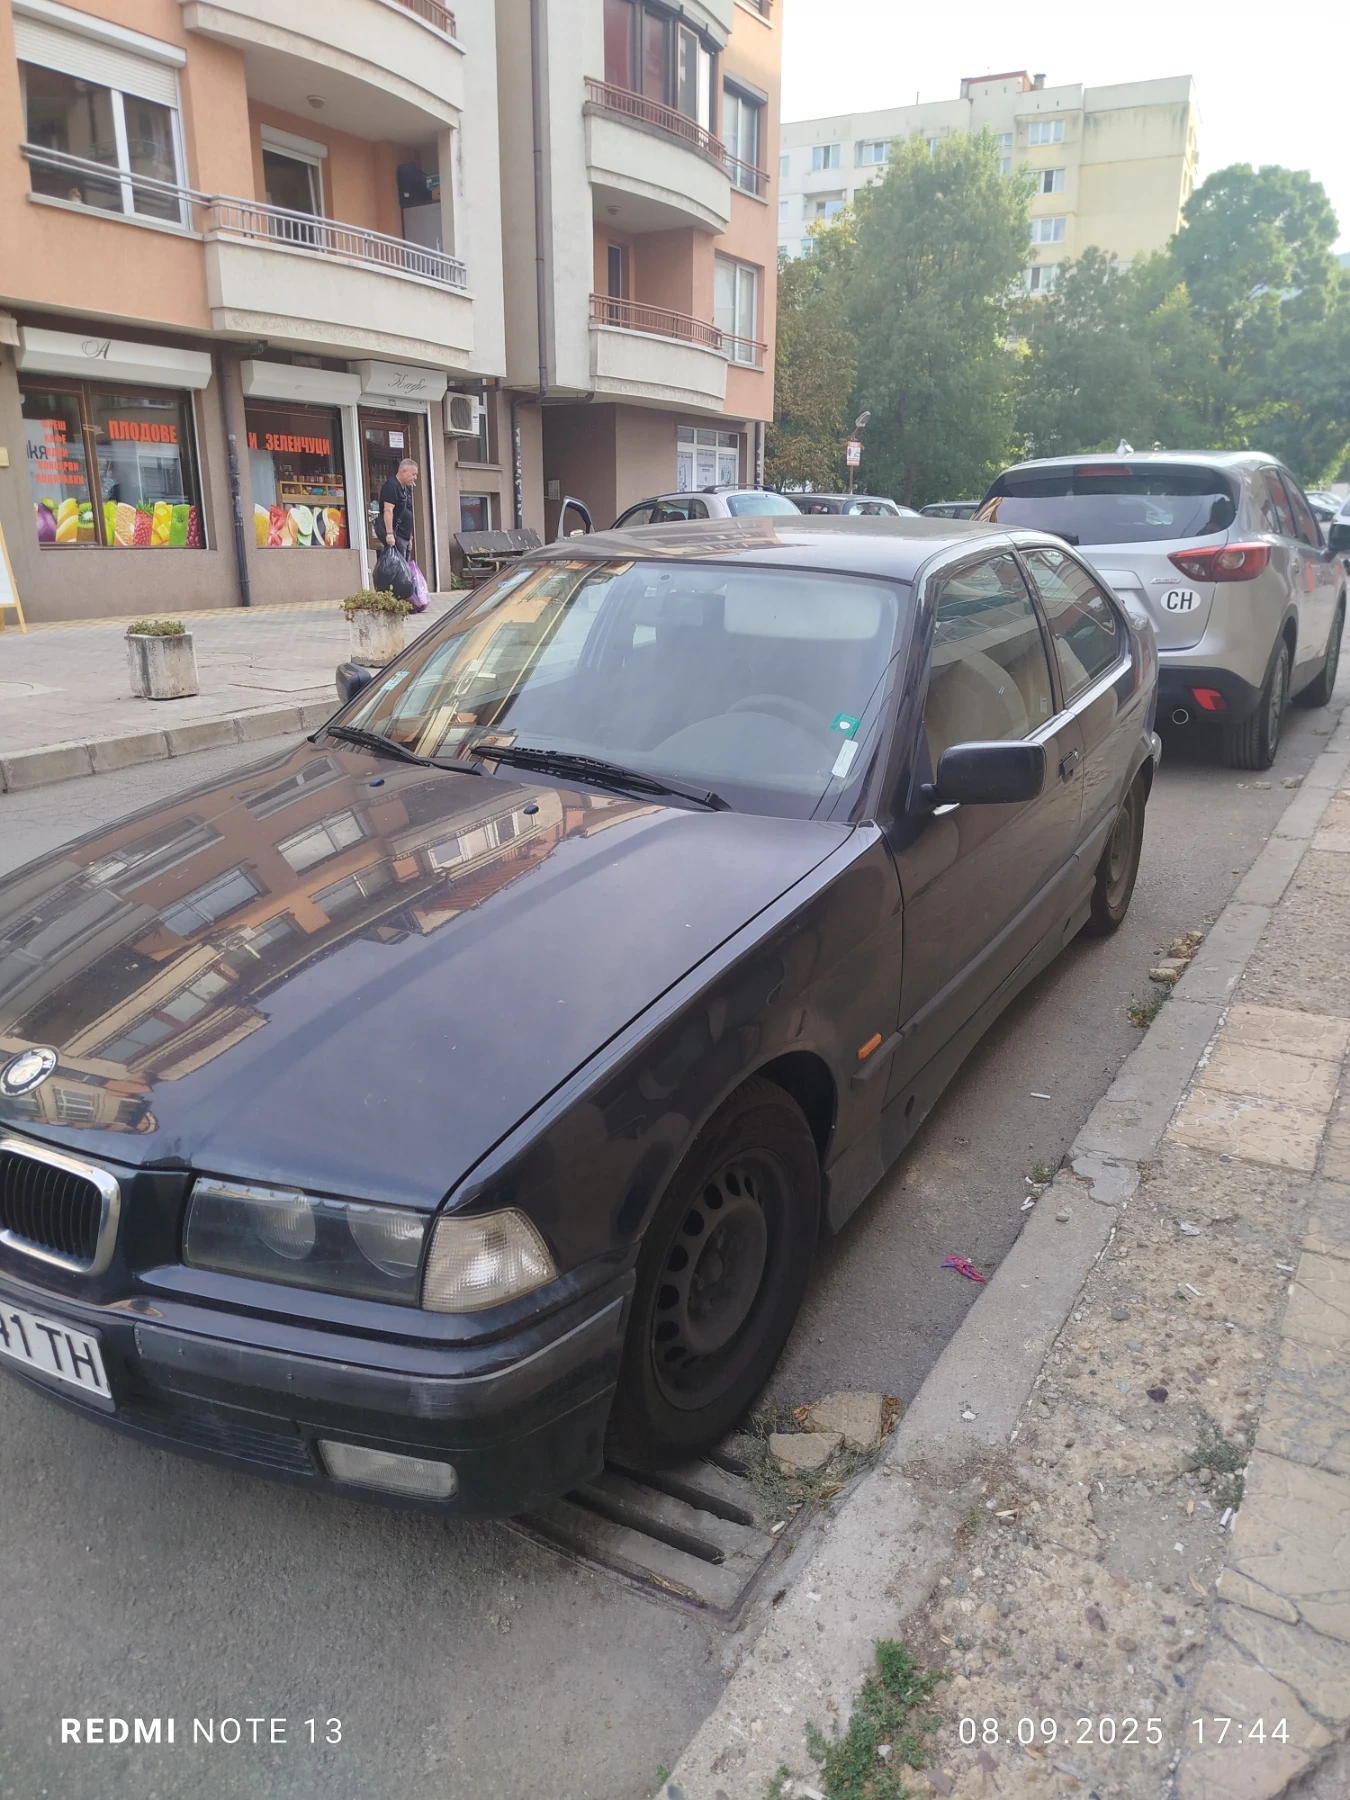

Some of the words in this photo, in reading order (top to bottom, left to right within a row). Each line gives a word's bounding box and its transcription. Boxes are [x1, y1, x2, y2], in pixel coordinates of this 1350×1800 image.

[387, 372, 428, 395] Кафе
[108, 419, 178, 444] ПЛОДОВЕ
[248, 431, 258, 450] И
[265, 433, 331, 457] ЗЕЛЕНЧУЦИ
[1166, 591, 1193, 610] CH
[35, 1321, 101, 1388] TH
